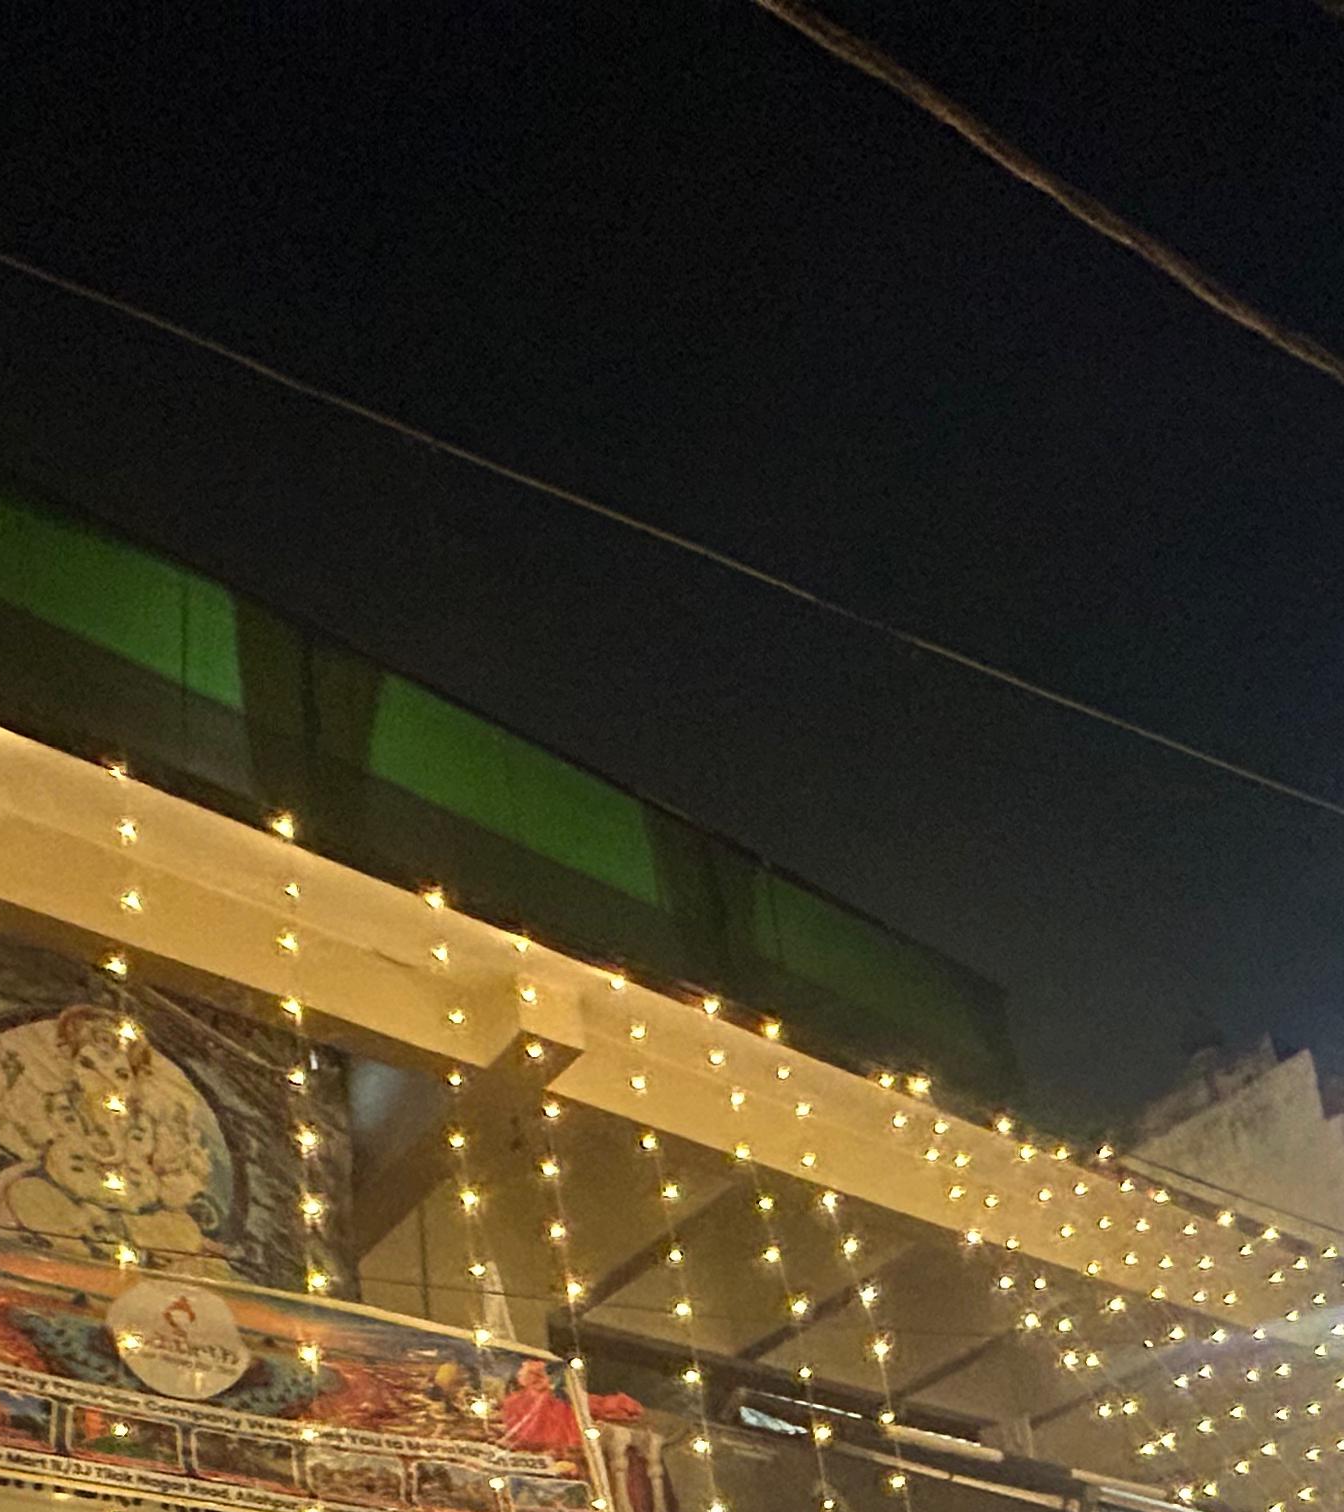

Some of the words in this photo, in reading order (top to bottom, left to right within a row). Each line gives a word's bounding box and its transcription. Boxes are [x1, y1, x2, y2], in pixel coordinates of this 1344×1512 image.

[147, 1400, 241, 1429] Company
[348, 1433, 381, 1449] You
[385, 1438, 404, 1450] to
[8, 1452, 46, 1469] Mart
